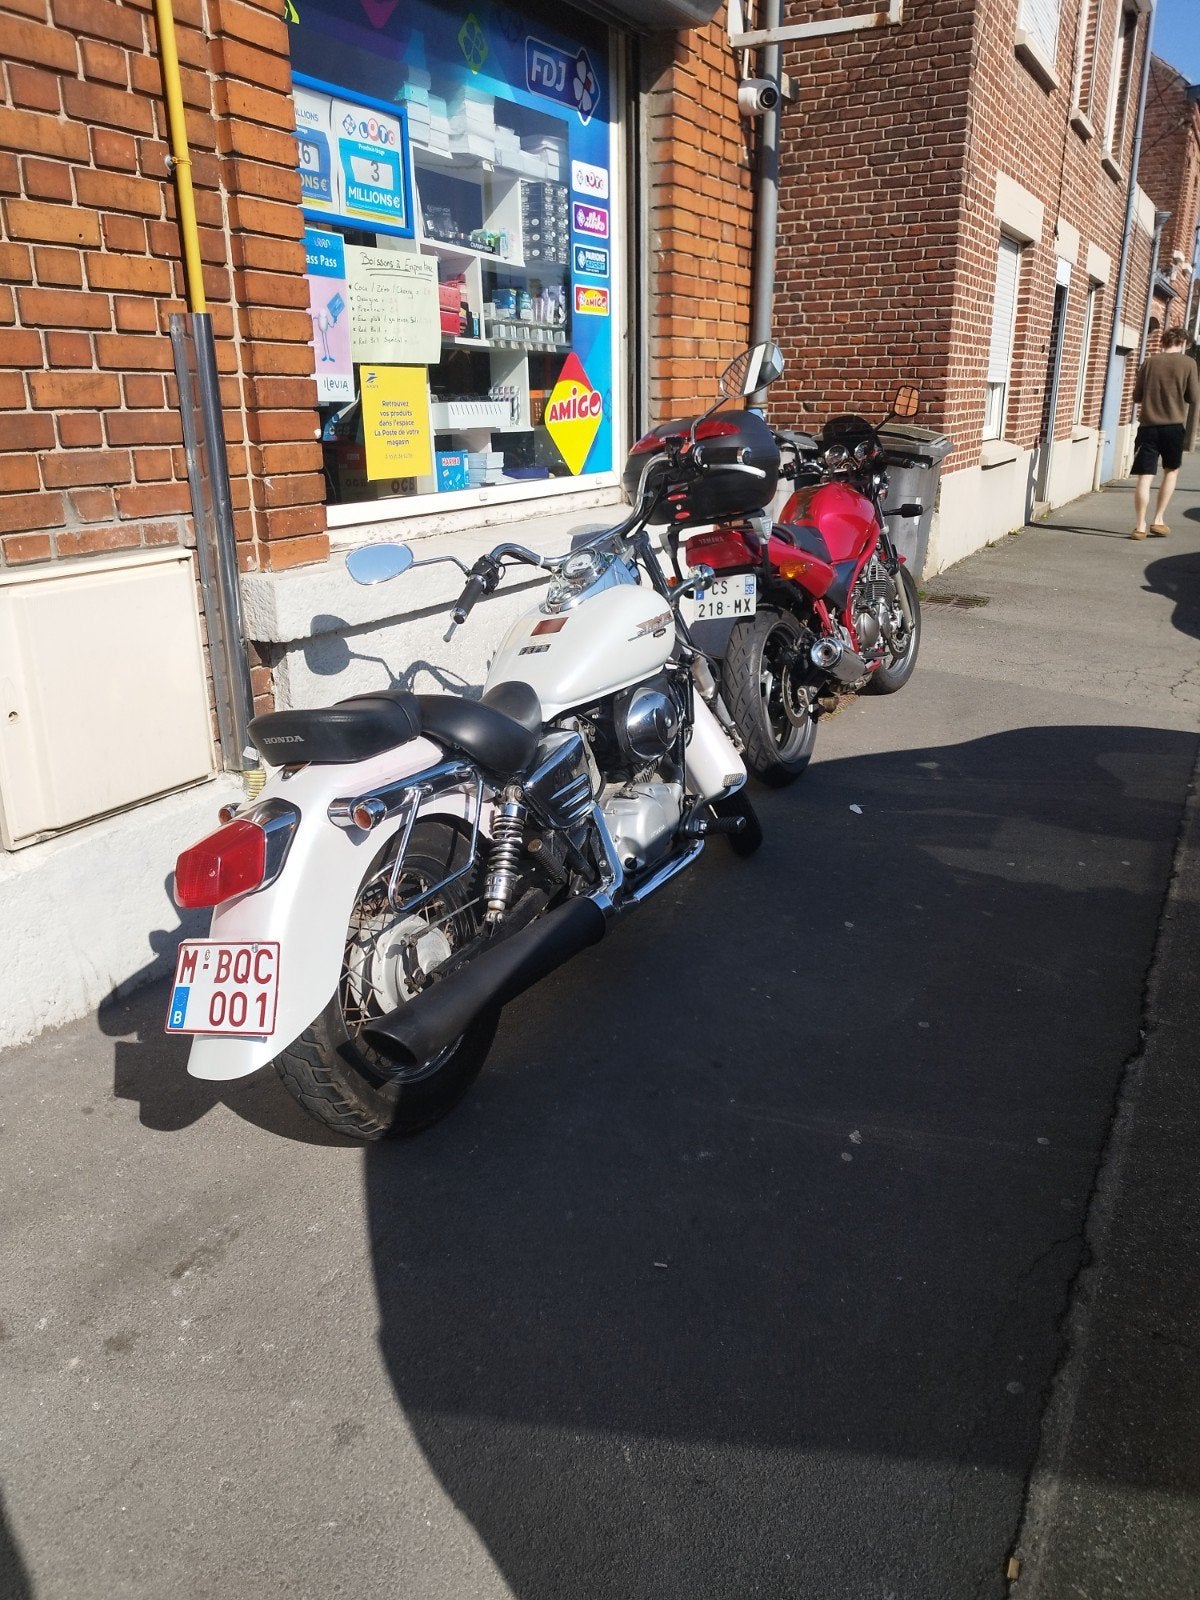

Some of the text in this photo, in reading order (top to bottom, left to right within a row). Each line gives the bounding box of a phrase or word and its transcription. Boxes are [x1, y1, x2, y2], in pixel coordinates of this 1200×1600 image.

[531, 49, 566, 92] FDJ
[295, 109, 319, 122] ILLIONS
[359, 118, 395, 145] LOTO
[299, 143, 311, 165] 6
[370, 160, 380, 182] 3
[305, 254, 337, 268] ass Pass
[549, 387, 601, 422] AMIGO
[390, 410, 413, 418] produits
[393, 419, 414, 427] l'espace
[386, 439, 410, 447] magasin
[390, 479, 416, 494] OCB
[711, 580, 728, 596] CS
[745, 585, 754, 595] 59
[698, 598, 751, 618] 218-MX
[263, 735, 305, 745] HONDA
[208, 990, 267, 1028] 001
[173, 1010, 182, 1025] B
